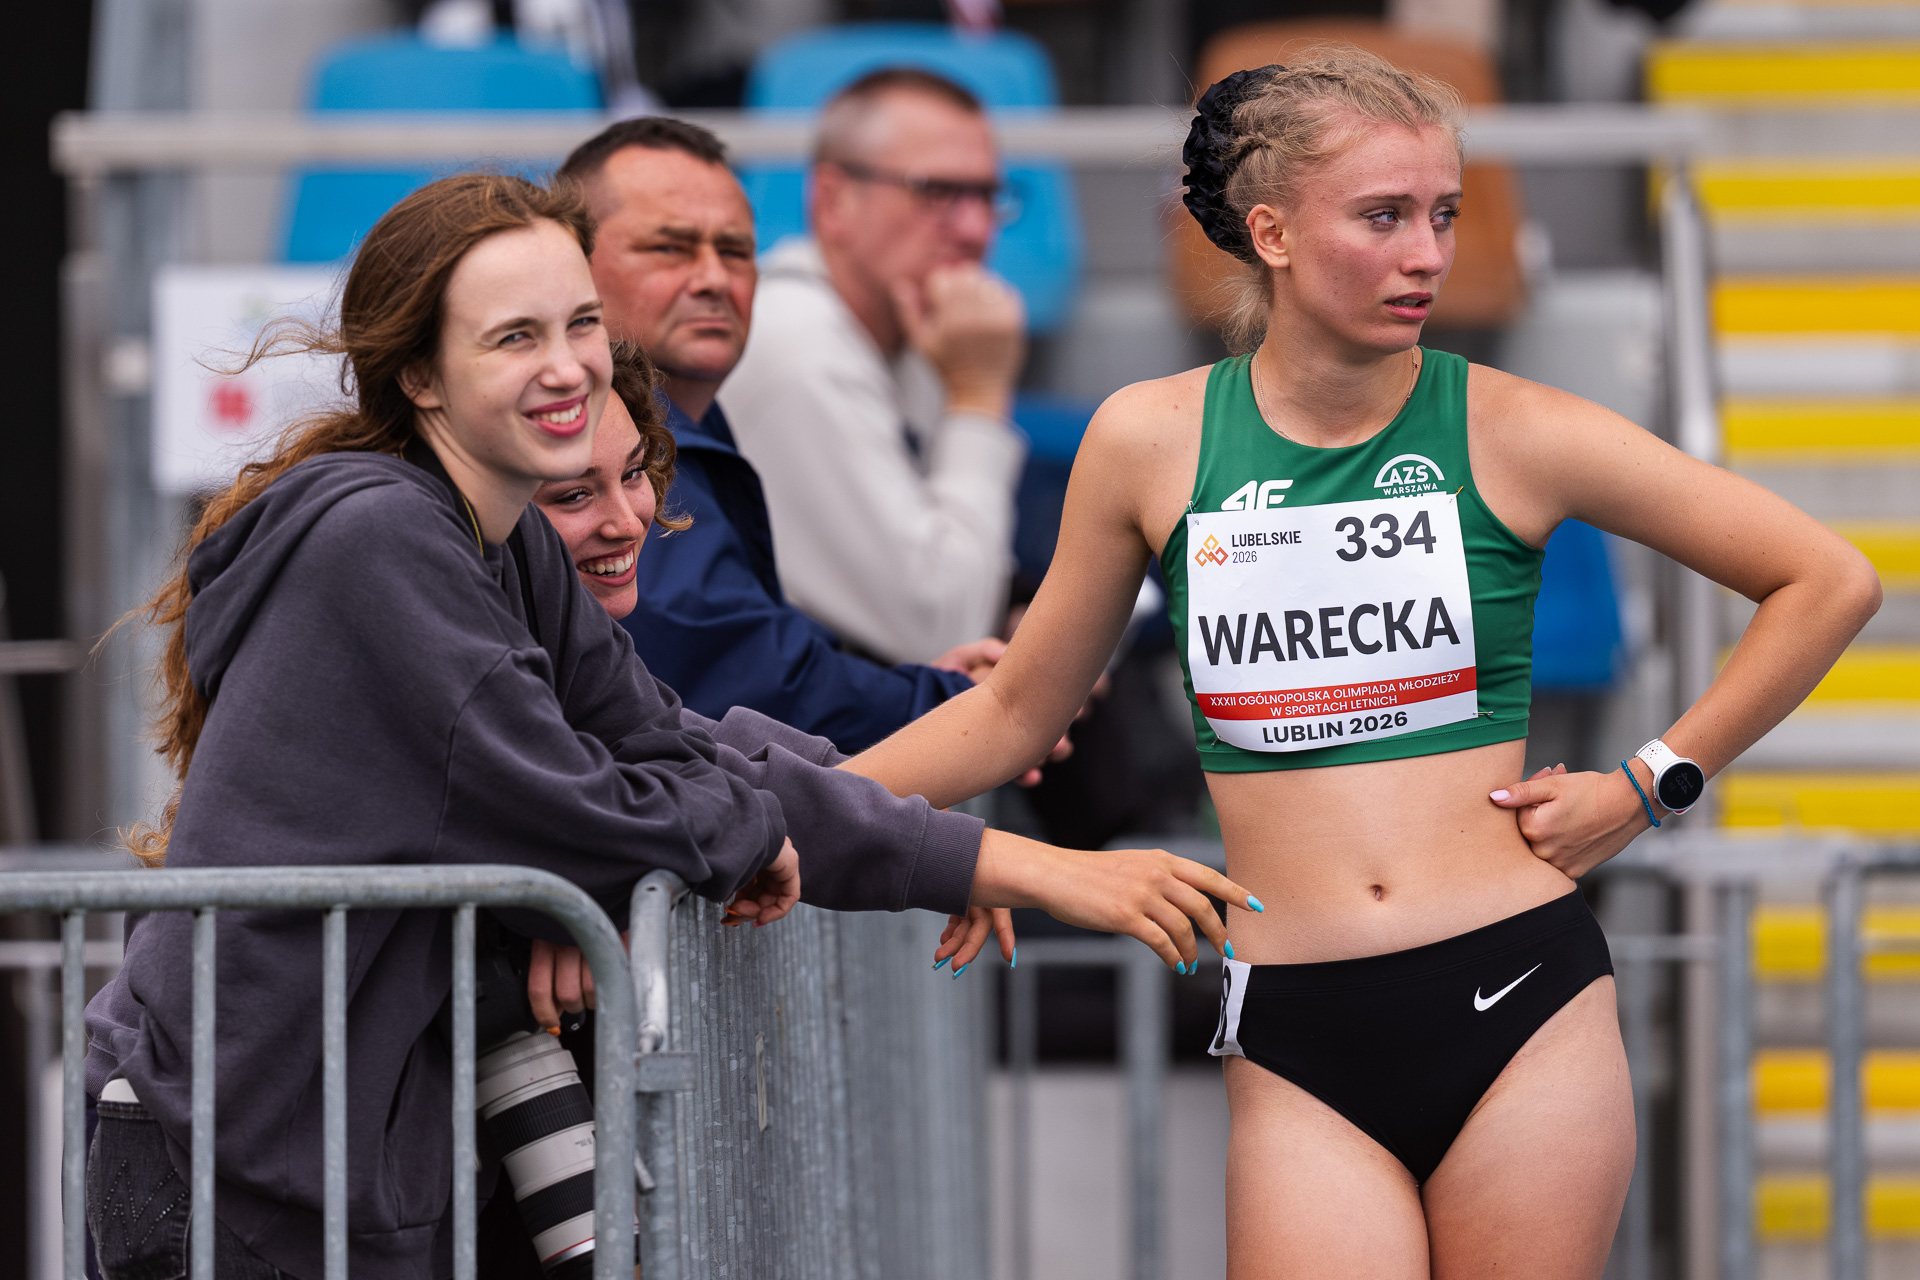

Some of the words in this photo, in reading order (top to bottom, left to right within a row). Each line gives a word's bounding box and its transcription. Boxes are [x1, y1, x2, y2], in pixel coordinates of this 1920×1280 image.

[1389, 465, 1429, 485] AZS
[1221, 479, 1294, 511] 4F
[1383, 483, 1438, 496] WARSZAWA
[1231, 530, 1302, 547] LUBELSKIE
[1334, 510, 1437, 562] 334
[1232, 550, 1258, 564] 2026
[1198, 596, 1461, 666] WARECKA
[1210, 696, 1237, 706] XXXII
[1238, 690, 1331, 706] OGÓLNOPOLSKA
[1333, 683, 1396, 699] OLIMPIADA
[1399, 672, 1461, 691] MŁODZIEŻY
[1270, 707, 1282, 717] W
[1285, 701, 1348, 716] SPORTACH
[1350, 695, 1398, 710] LETNICH
[1262, 720, 1344, 744] LUBLIN
[1349, 711, 1408, 735] 2026
